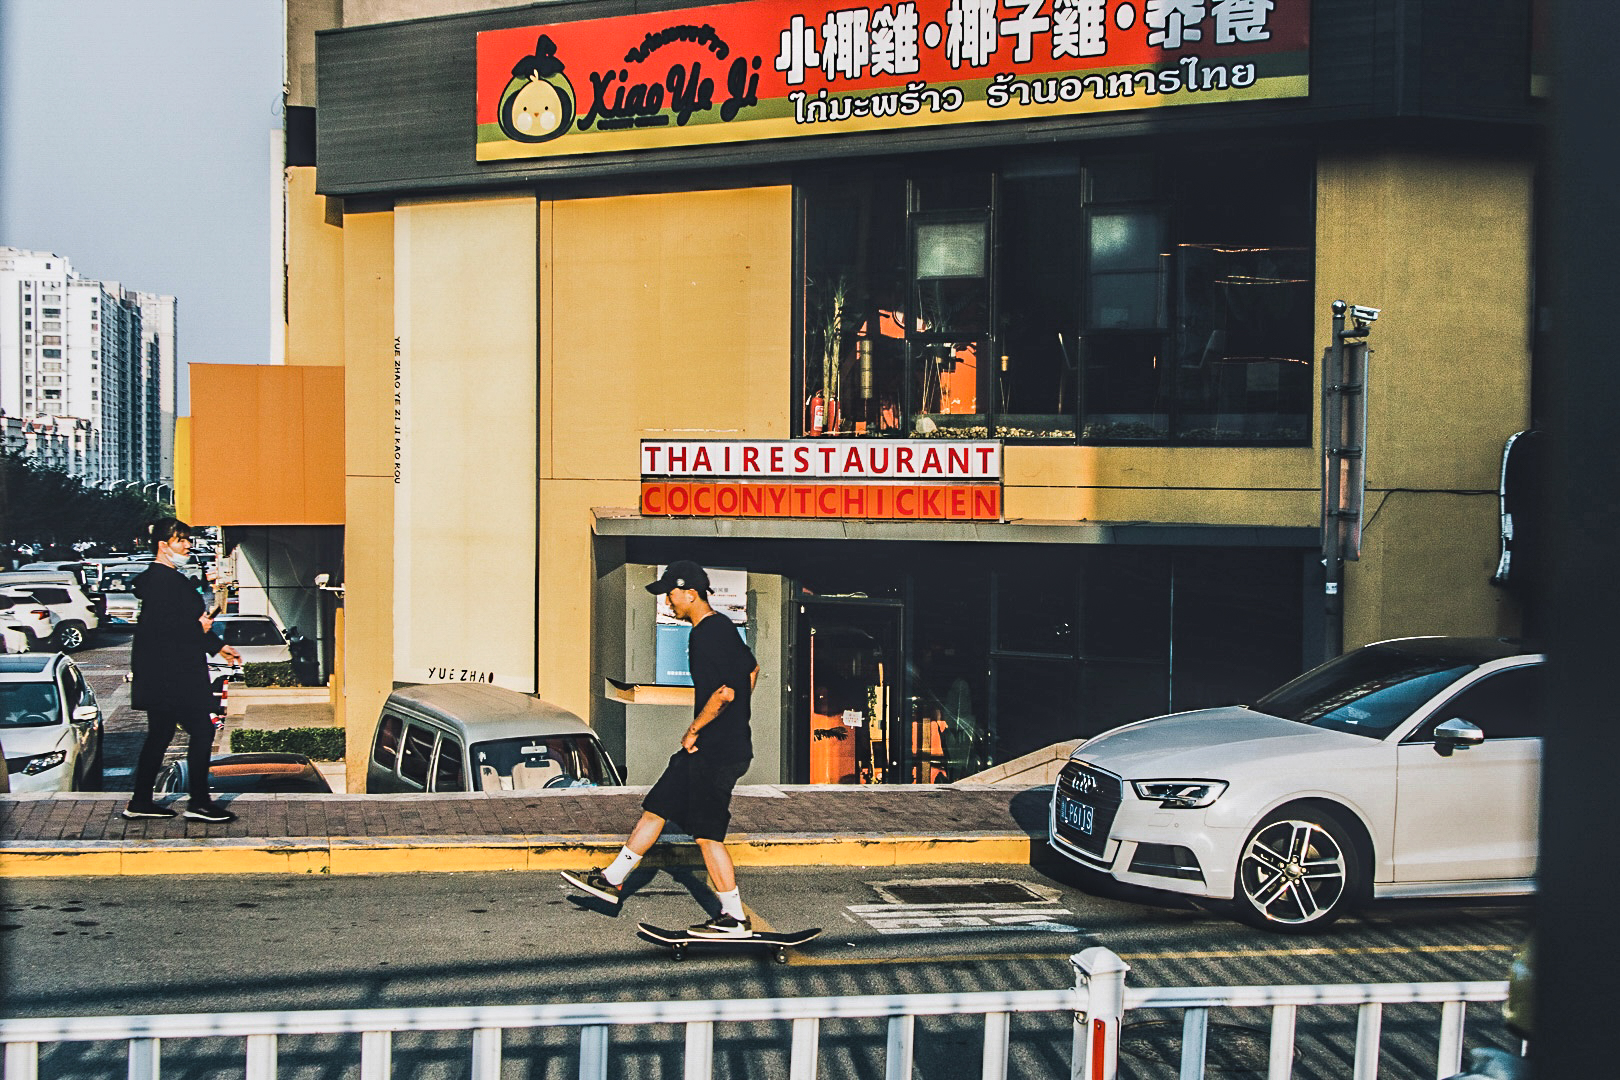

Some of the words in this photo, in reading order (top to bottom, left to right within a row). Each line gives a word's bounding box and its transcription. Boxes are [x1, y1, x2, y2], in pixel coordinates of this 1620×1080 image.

[577, 70, 665, 130] Xiao
[665, 62, 715, 127] Ye
[720, 56, 762, 123] Ji
[790, 83, 963, 124] ไก่มะพร้าว
[986, 58, 1256, 109] ร้านอาหารไทย
[394, 391, 401, 406] YE
[394, 409, 401, 421] ZI
[394, 424, 401, 435] JI
[428, 666, 455, 680] YUE
[460, 669, 494, 684] ZHAO
